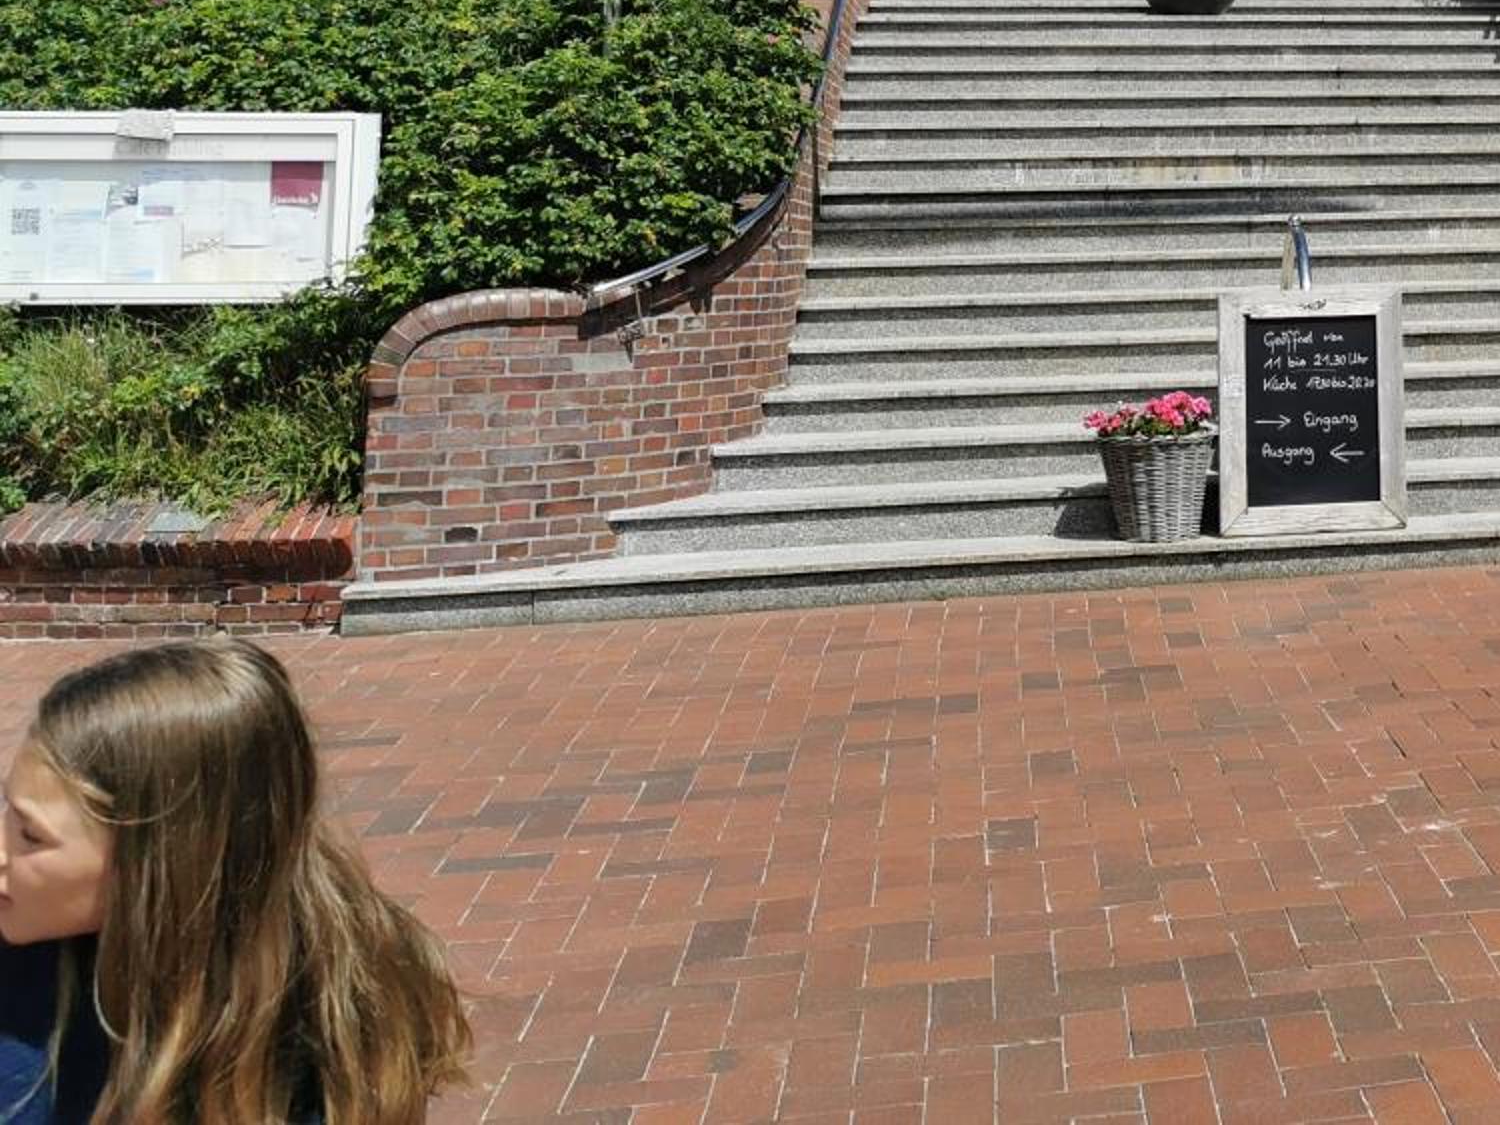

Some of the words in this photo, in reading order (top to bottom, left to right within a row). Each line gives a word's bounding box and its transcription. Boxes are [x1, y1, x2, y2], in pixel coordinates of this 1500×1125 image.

[1263, 355, 1282, 370] 11
[1287, 355, 1307, 368] bis
[1347, 351, 1369, 366] Uhr
[1263, 375, 1297, 391] Küche
[1303, 410, 1360, 433] Eingang
[1261, 442, 1316, 465] Ausgang
